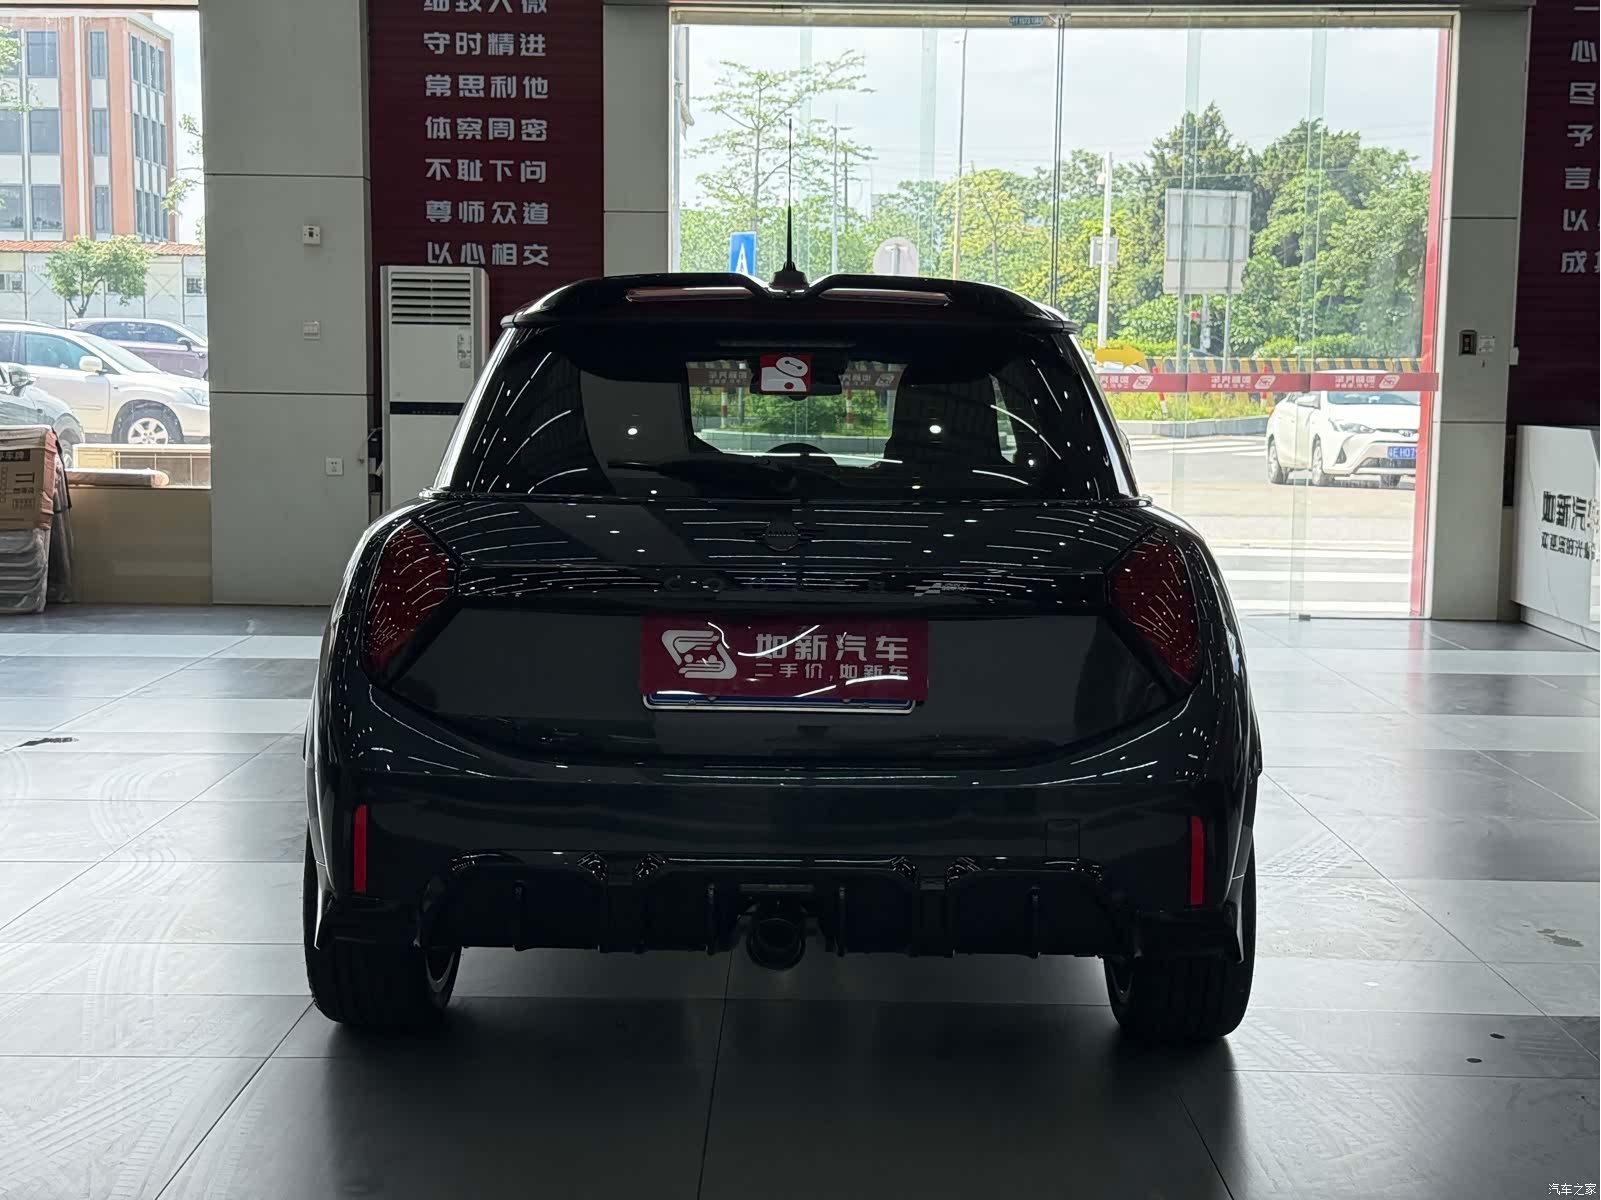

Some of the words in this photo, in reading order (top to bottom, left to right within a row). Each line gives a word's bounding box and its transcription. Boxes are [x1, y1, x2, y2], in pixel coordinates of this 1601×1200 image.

[423, 31, 547, 57] 守时精进
[1570, 39, 1598, 63] 心
[425, 74, 549, 99] 常思利他
[1569, 82, 1597, 105] 尽
[425, 116, 548, 141] 体察周密
[1566, 124, 1594, 147] 予
[425, 158, 547, 183] 不耻下问
[1564, 166, 1600, 190] 言
[425, 199, 549, 225] 尊师众道
[1562, 208, 1600, 232] 以
[426, 241, 549, 266] 以心相交
[1560, 250, 1600, 273] 成
[755, 632, 909, 662] 如新汽车
